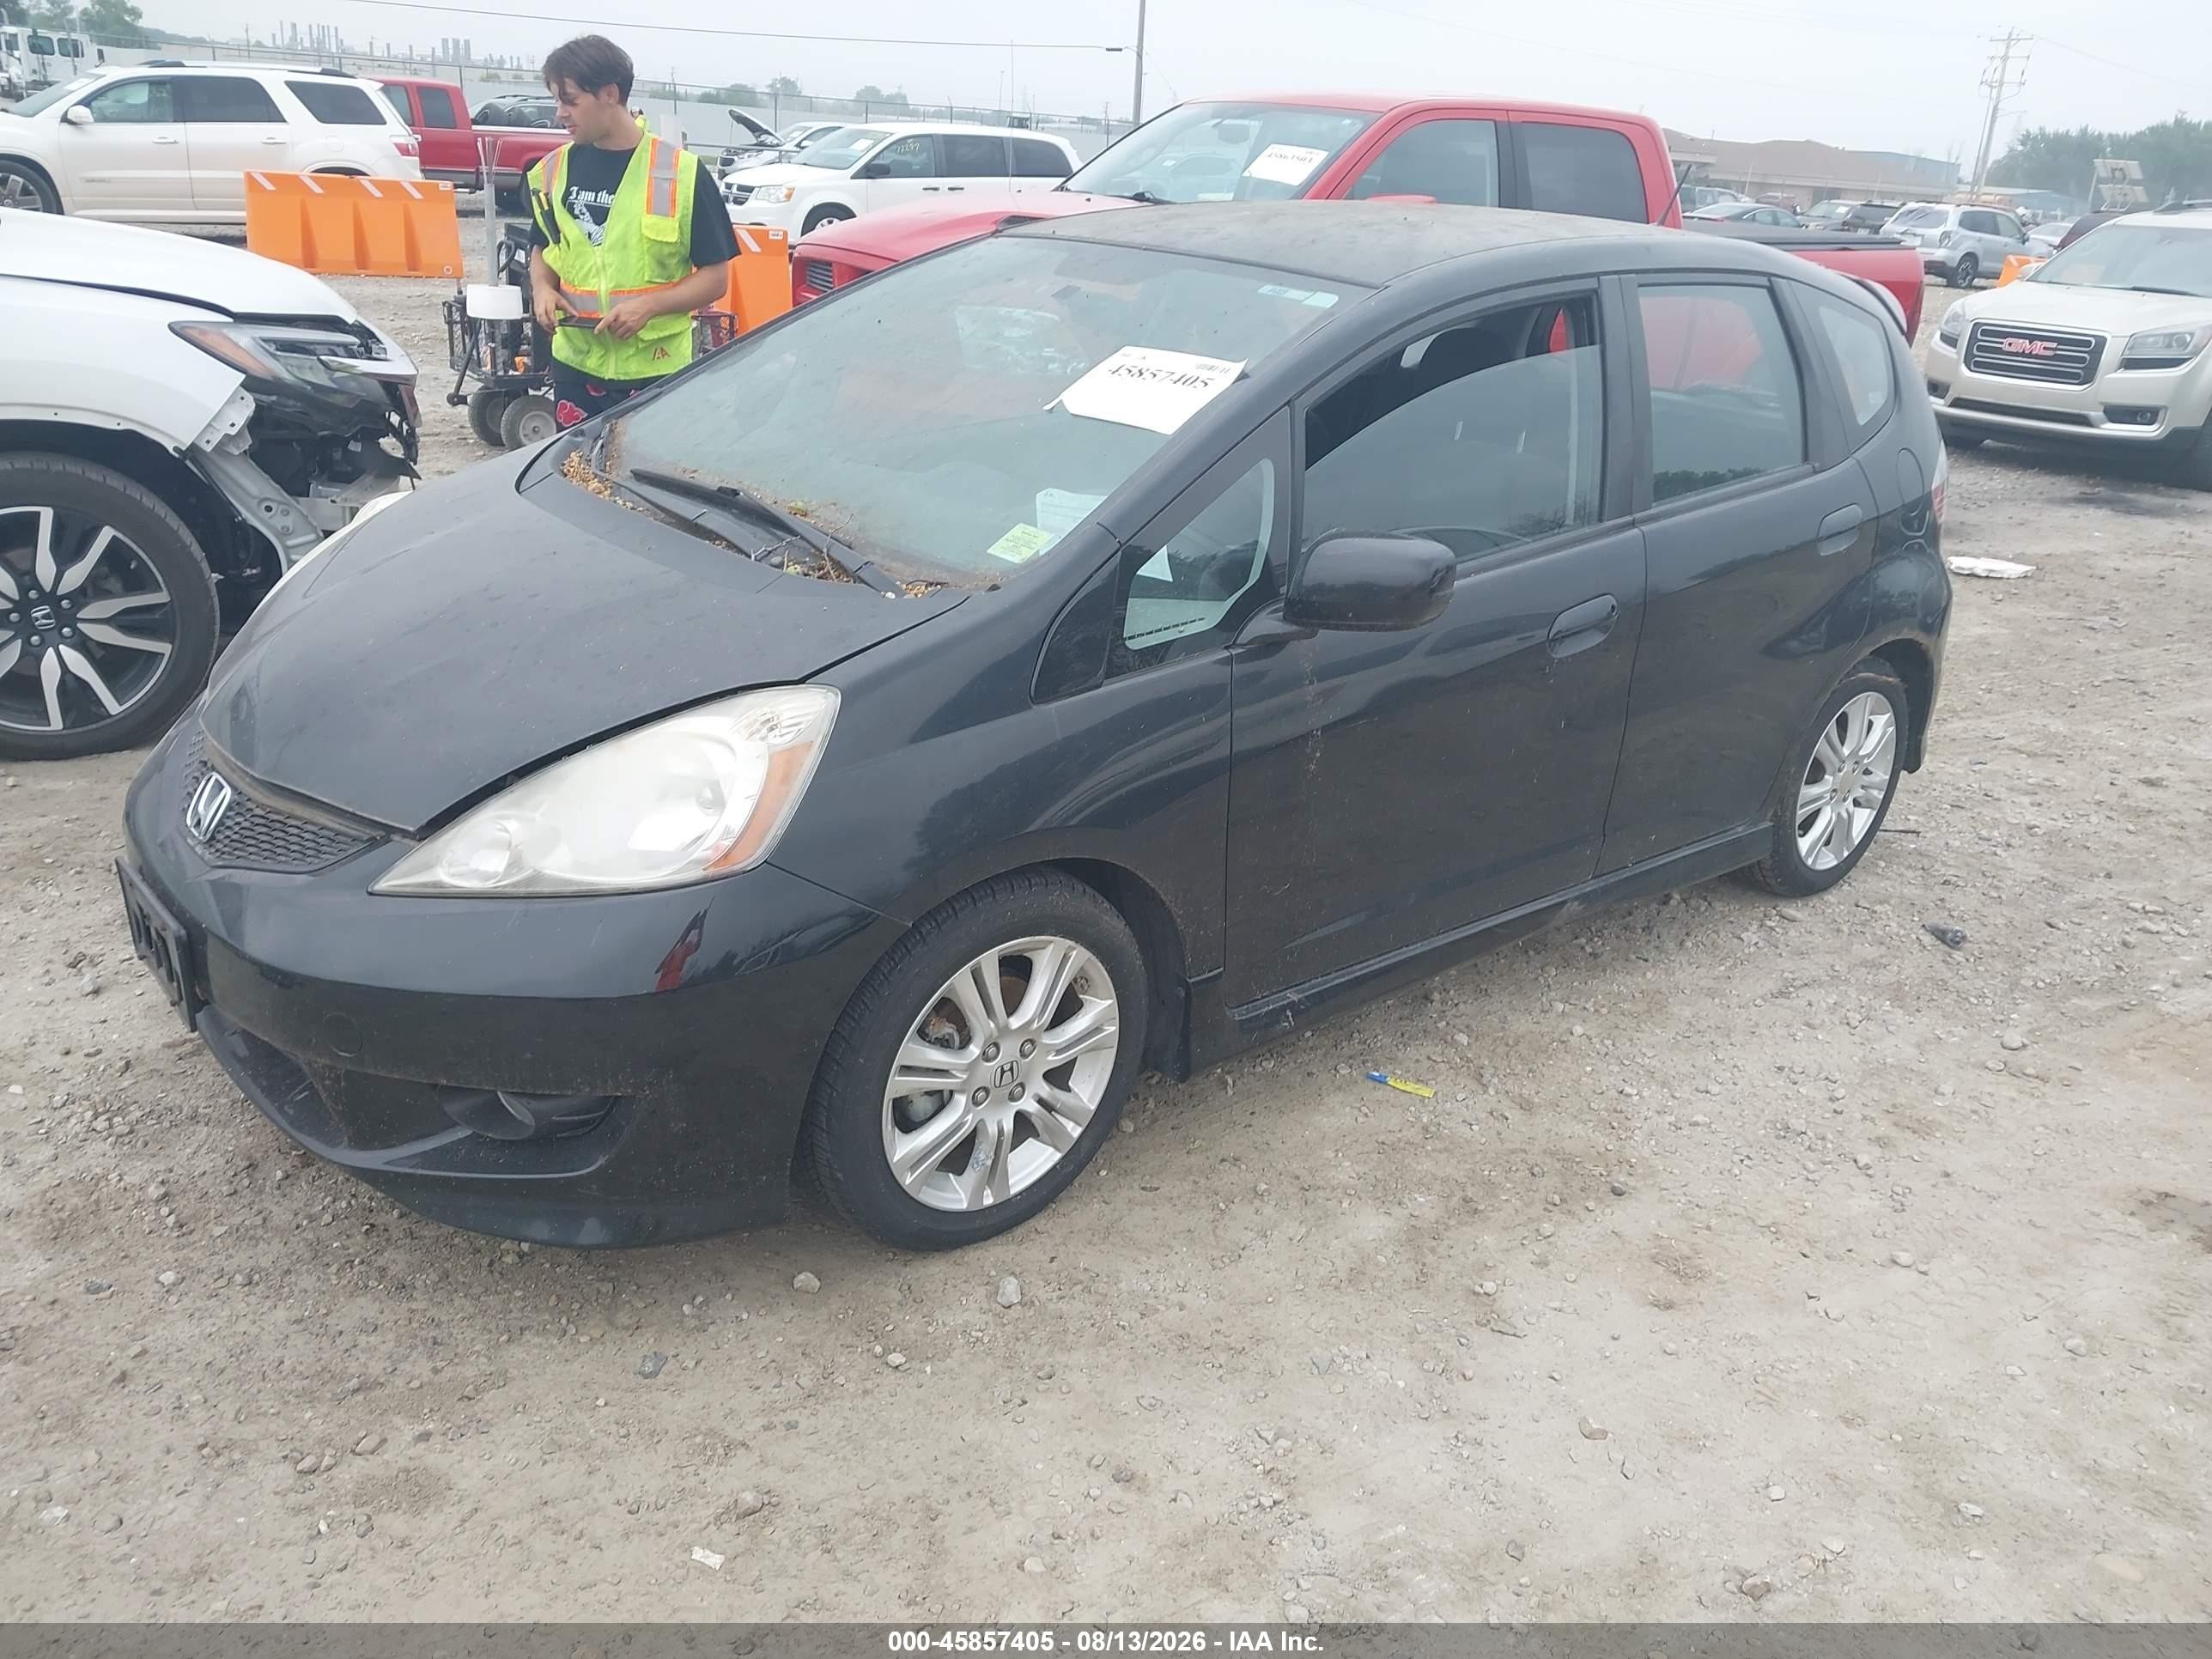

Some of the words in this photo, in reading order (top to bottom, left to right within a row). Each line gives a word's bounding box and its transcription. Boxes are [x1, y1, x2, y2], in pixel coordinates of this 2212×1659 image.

[568, 185, 579, 199] I
[578, 189, 595, 202] am
[596, 189, 615, 204] the
[2002, 337, 2058, 356] GMC
[1109, 363, 1215, 389] 45857405
